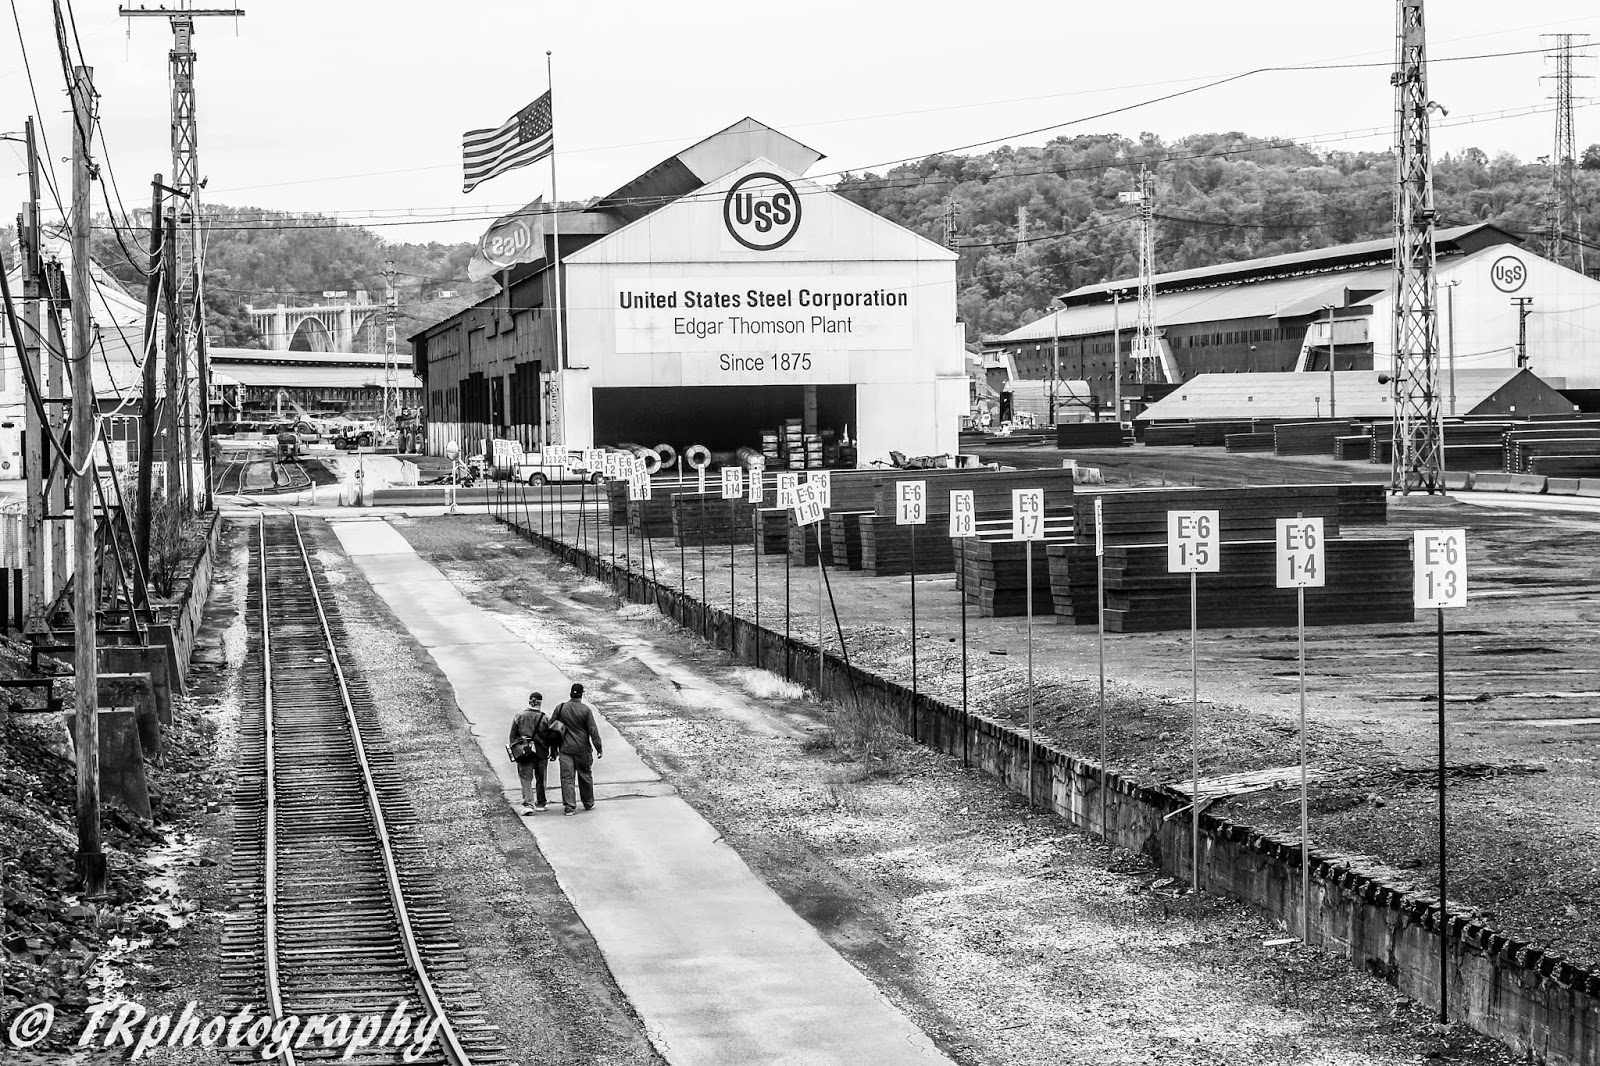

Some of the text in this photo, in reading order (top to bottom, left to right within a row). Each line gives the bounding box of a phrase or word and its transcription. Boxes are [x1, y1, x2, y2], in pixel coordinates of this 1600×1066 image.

[735, 193, 791, 233] USS
[1496, 265, 1522, 284] USS
[619, 288, 908, 311] United States Steel Corporation
[674, 315, 852, 339] Edgar Thomson Plant
[719, 352, 812, 371] Since 1875
